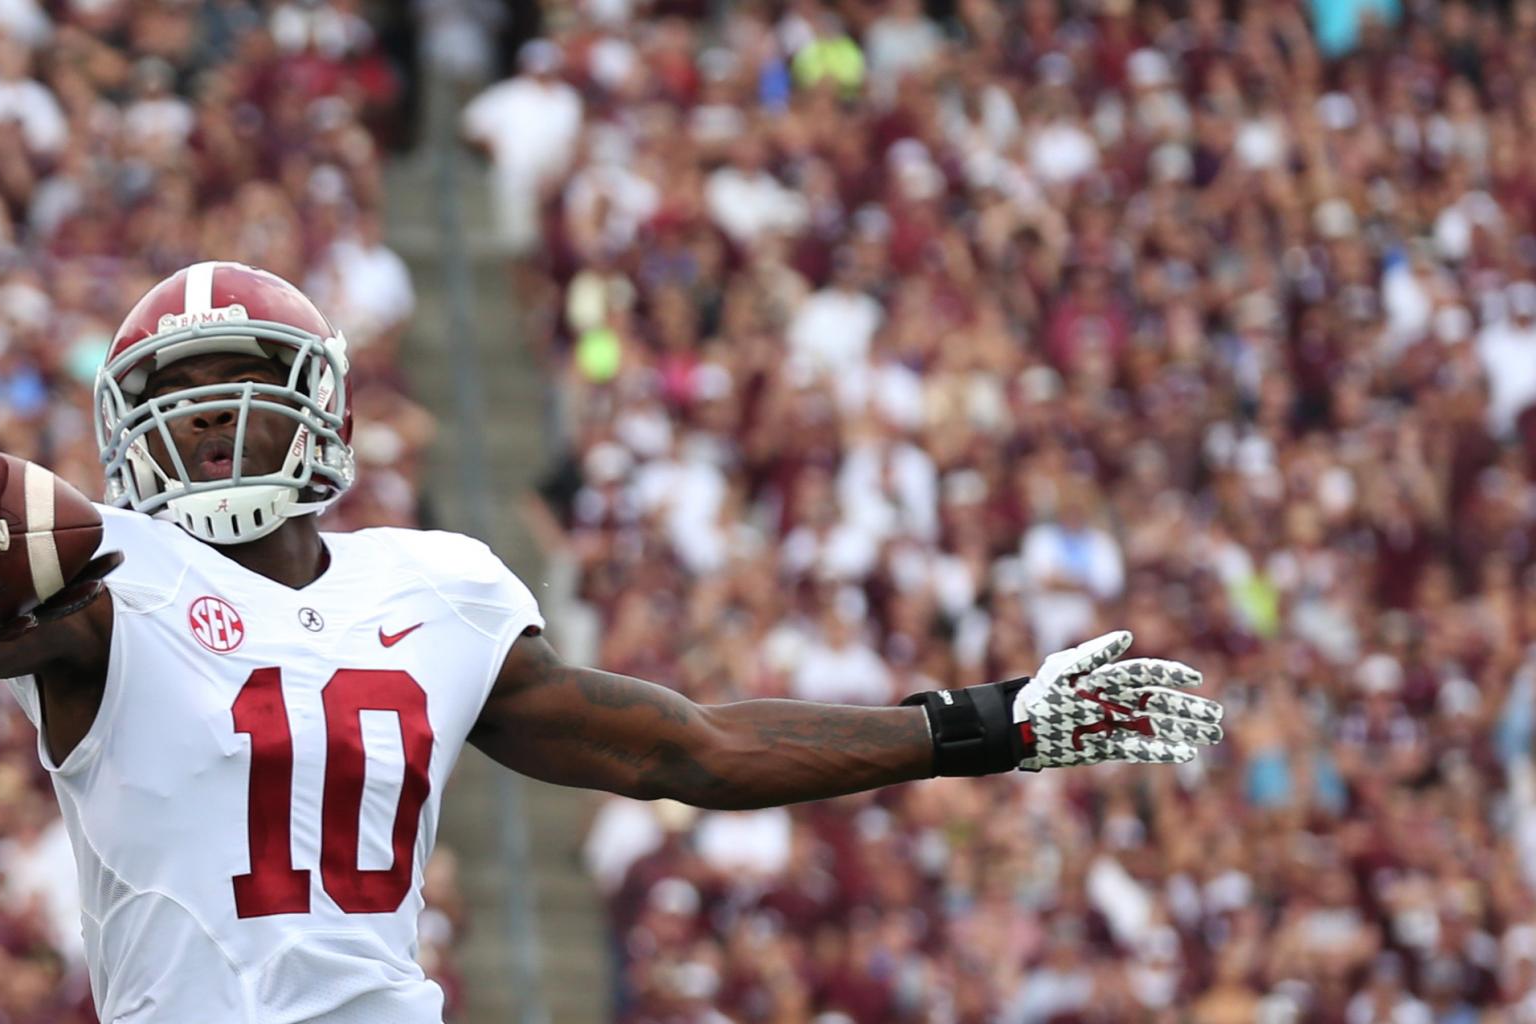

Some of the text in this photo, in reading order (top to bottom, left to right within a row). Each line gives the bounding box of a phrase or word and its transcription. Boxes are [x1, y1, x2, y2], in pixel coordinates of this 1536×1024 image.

[181, 312, 225, 327] BAMA
[189, 596, 244, 651] SEC
[230, 666, 434, 919] 10
